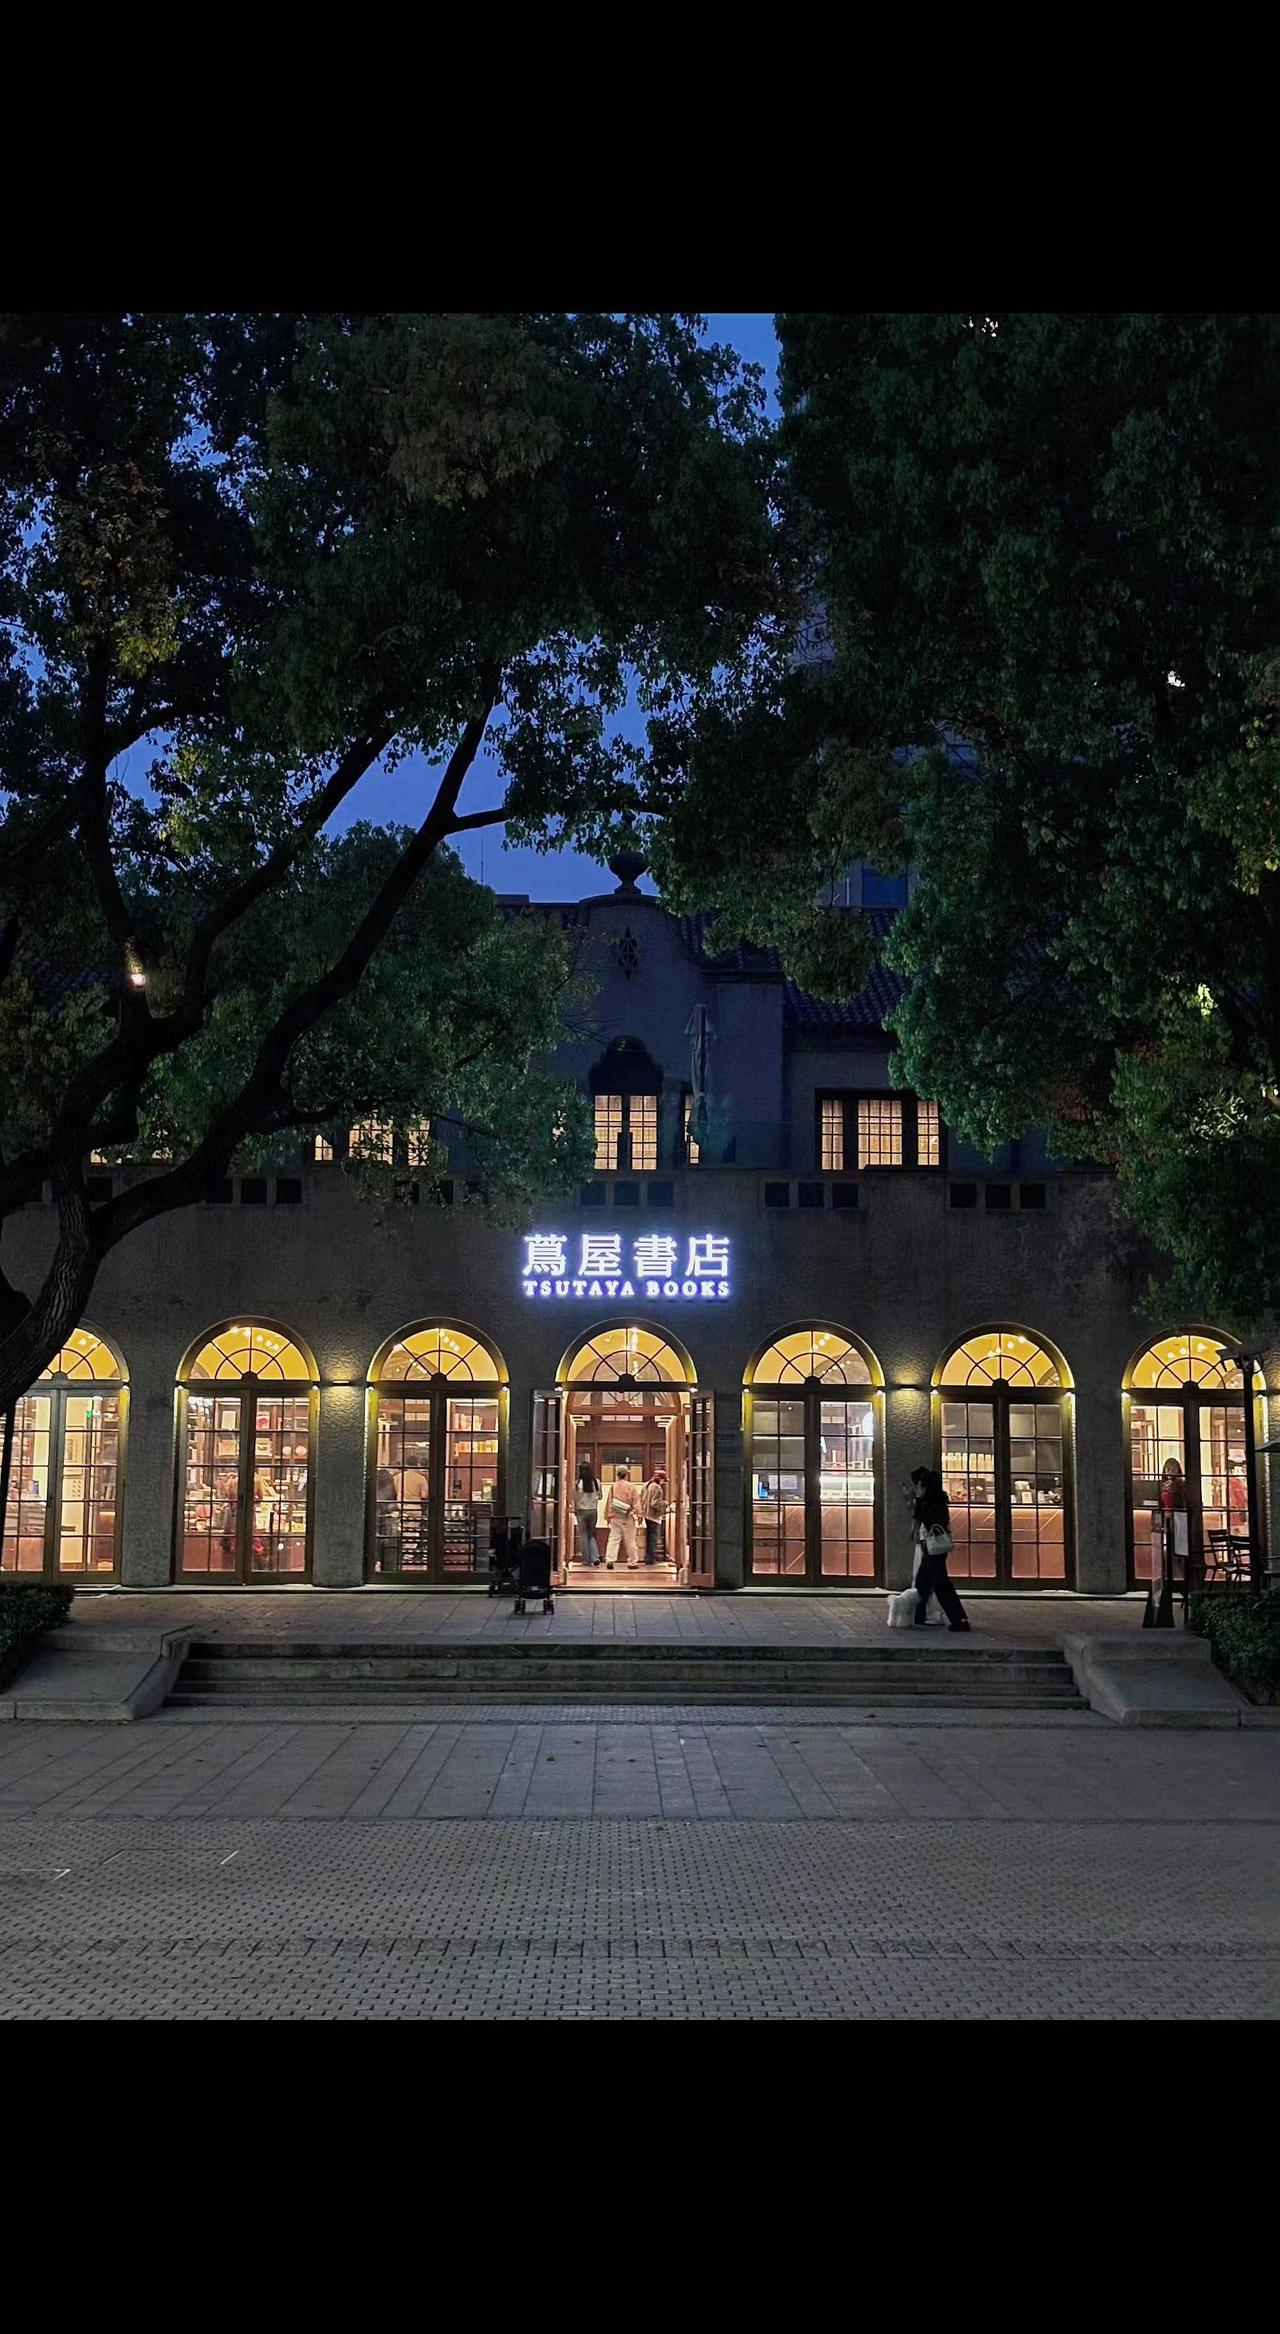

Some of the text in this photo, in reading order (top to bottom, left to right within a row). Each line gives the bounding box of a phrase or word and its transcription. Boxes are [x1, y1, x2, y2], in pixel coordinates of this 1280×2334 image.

[521, 1233, 730, 1277] 蔦屋書店
[522, 1280, 730, 1297] TSUTAYA BOOKS
